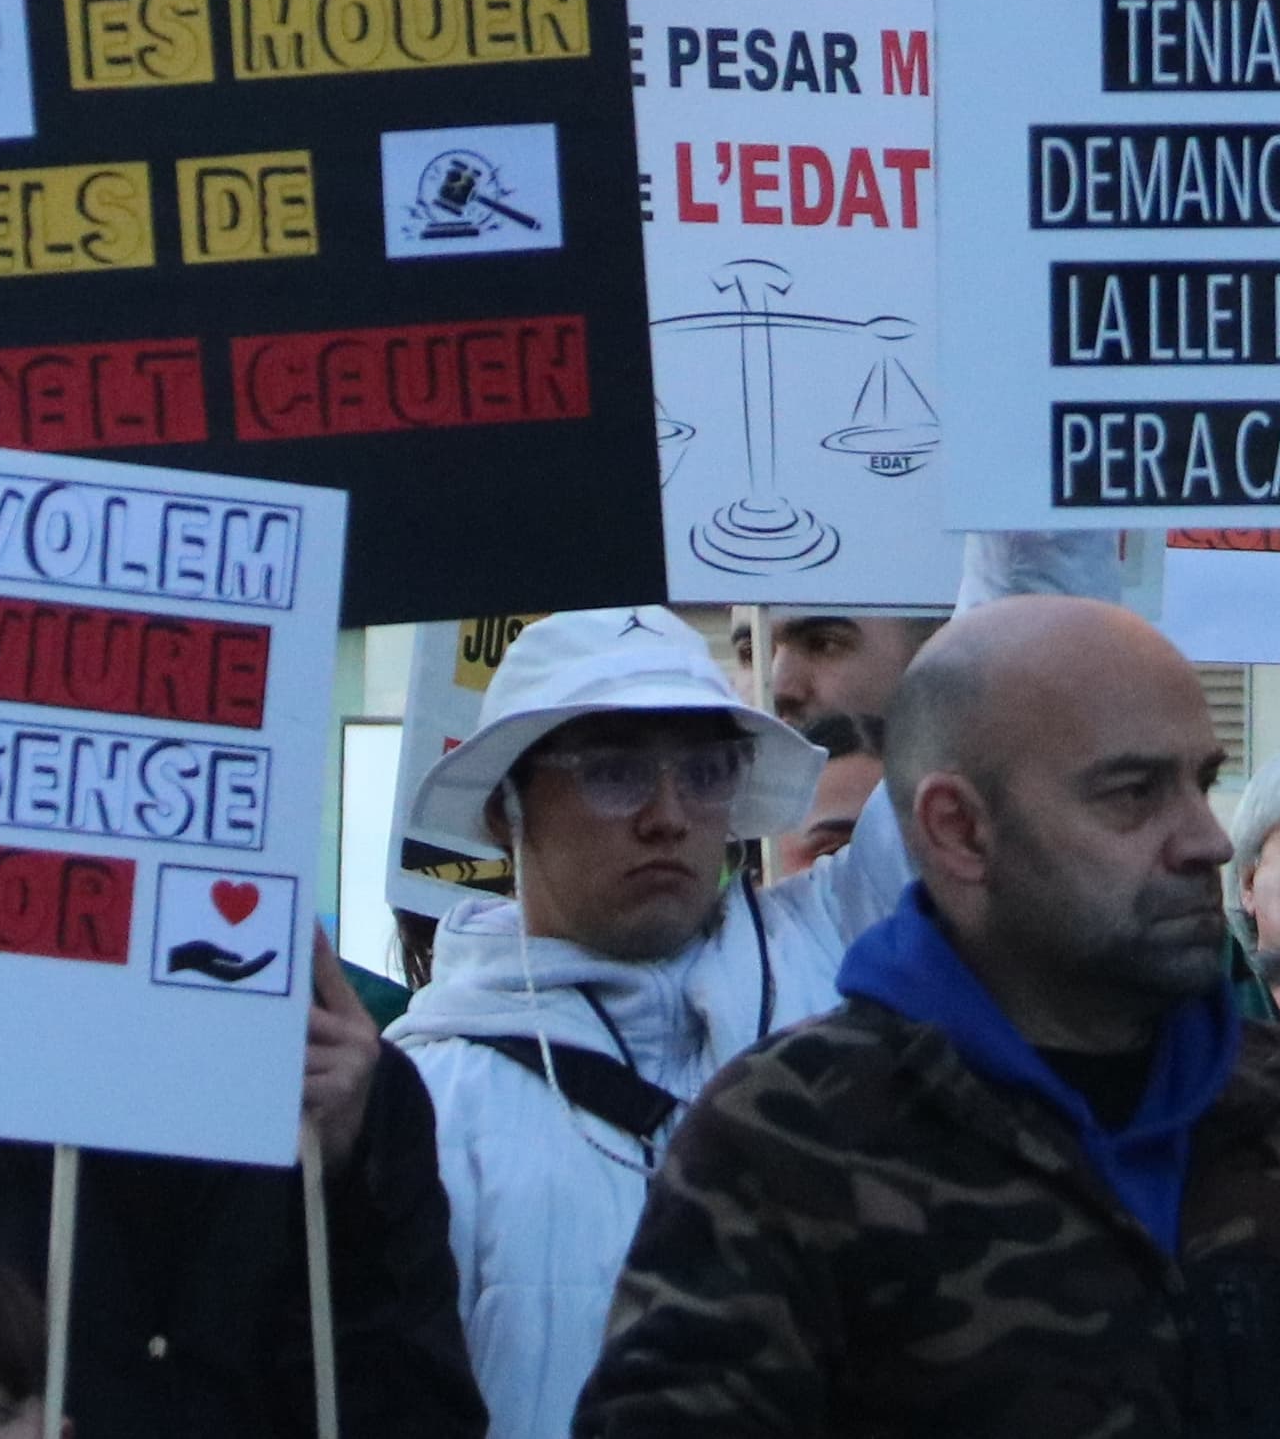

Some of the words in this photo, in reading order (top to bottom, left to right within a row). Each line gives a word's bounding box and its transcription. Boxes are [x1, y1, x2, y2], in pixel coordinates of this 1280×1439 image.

[667, 26, 863, 94] PESAR
[880, 29, 930, 97] M
[195, 163, 314, 256] DE
[676, 141, 931, 230] L'EDAT
[1067, 273, 1131, 361] LA
[1149, 272, 1252, 360] LLEI
[870, 455, 912, 470] EDAT
[1062, 412, 1168, 499] PER
[1182, 412, 1219, 499] A
